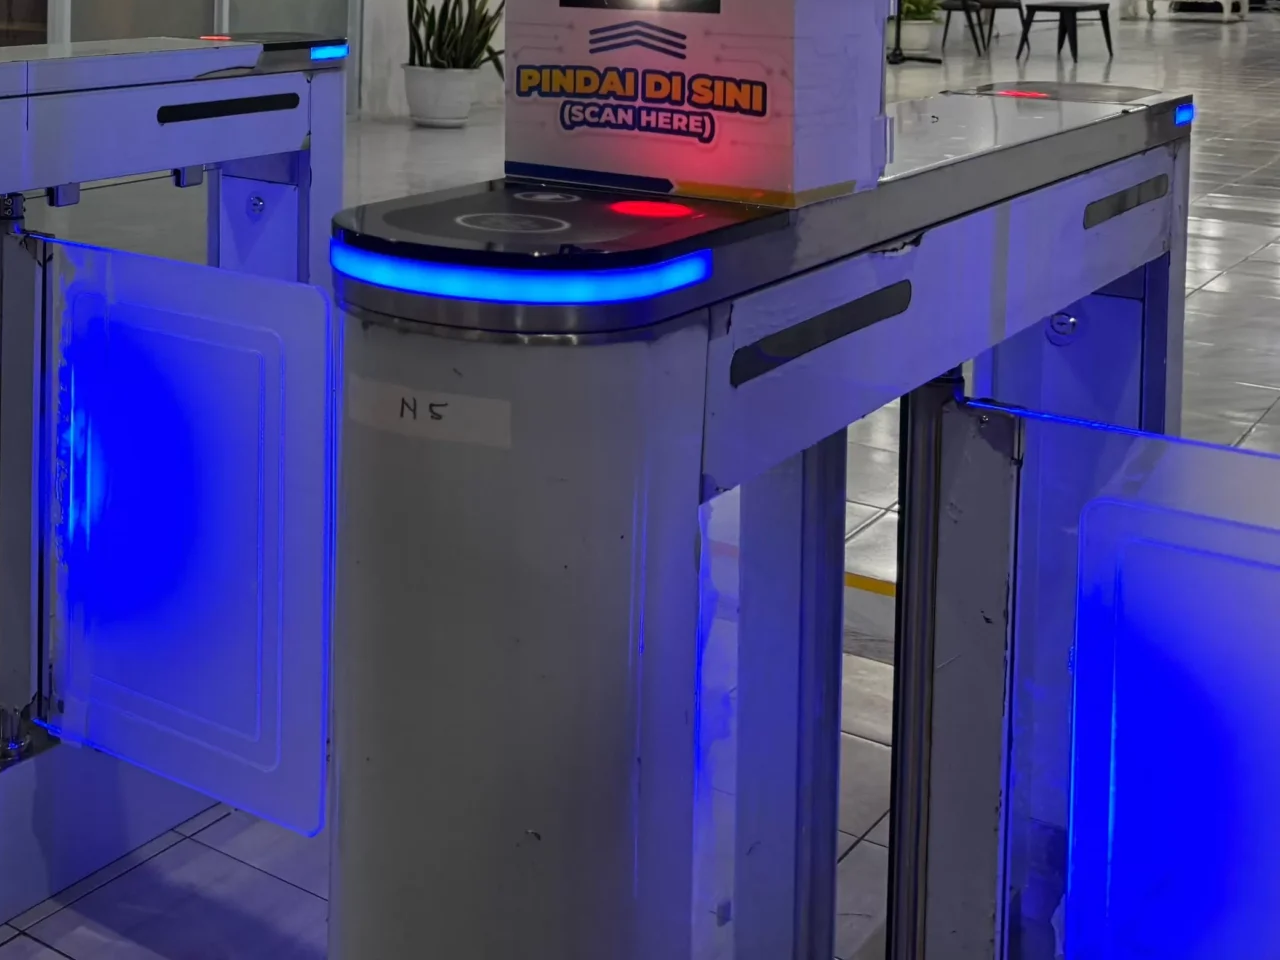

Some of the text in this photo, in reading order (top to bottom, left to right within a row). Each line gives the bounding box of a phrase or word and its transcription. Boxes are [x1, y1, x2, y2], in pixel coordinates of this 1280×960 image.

[518, 67, 767, 114] PINDAI DI SINI
[562, 103, 714, 140] (SCAN HERE)
